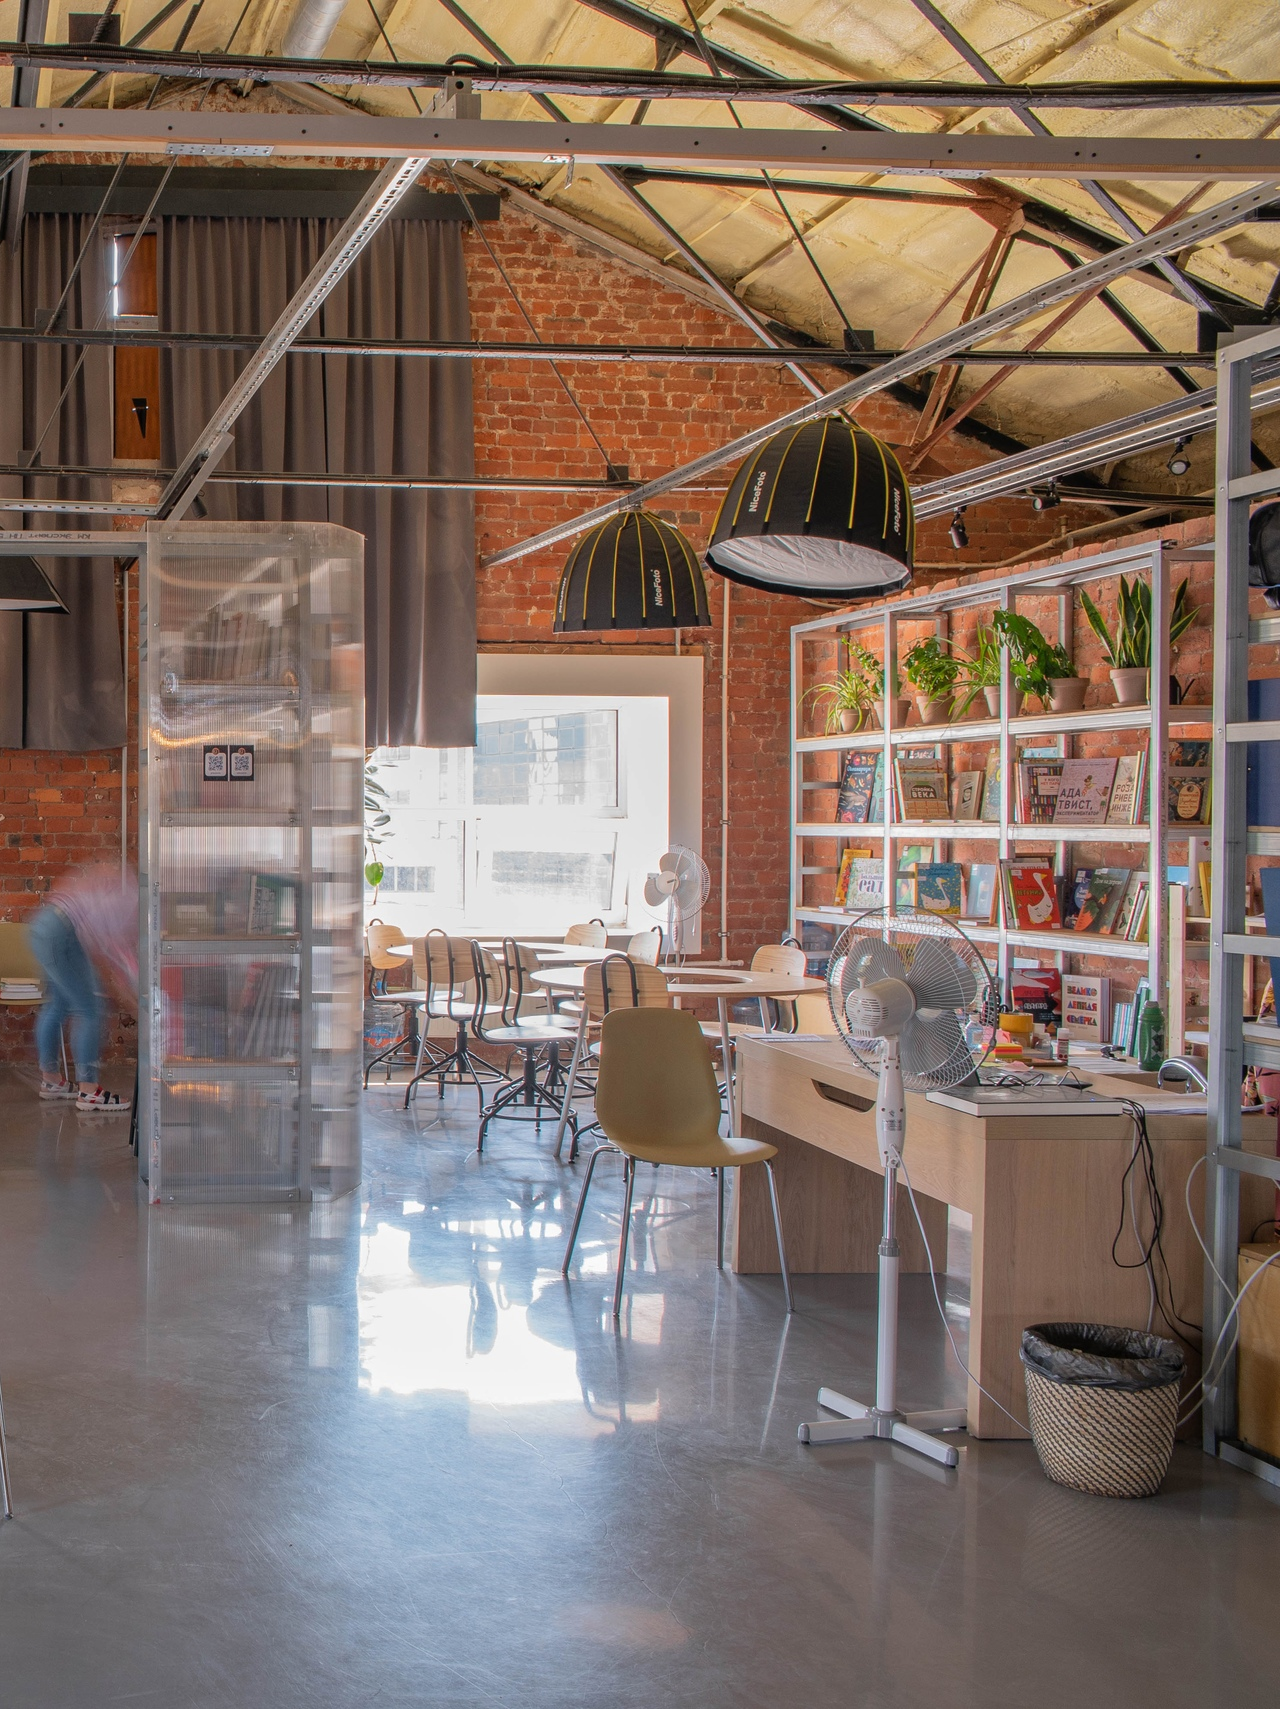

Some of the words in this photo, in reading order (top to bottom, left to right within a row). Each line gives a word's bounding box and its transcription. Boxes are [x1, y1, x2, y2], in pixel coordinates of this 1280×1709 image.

[748, 471, 767, 513] NiceFoto
[653, 569, 663, 606] NiceFoto
[1058, 799, 1093, 811] ТВИСТ,
[1059, 788, 1081, 799] АДА
